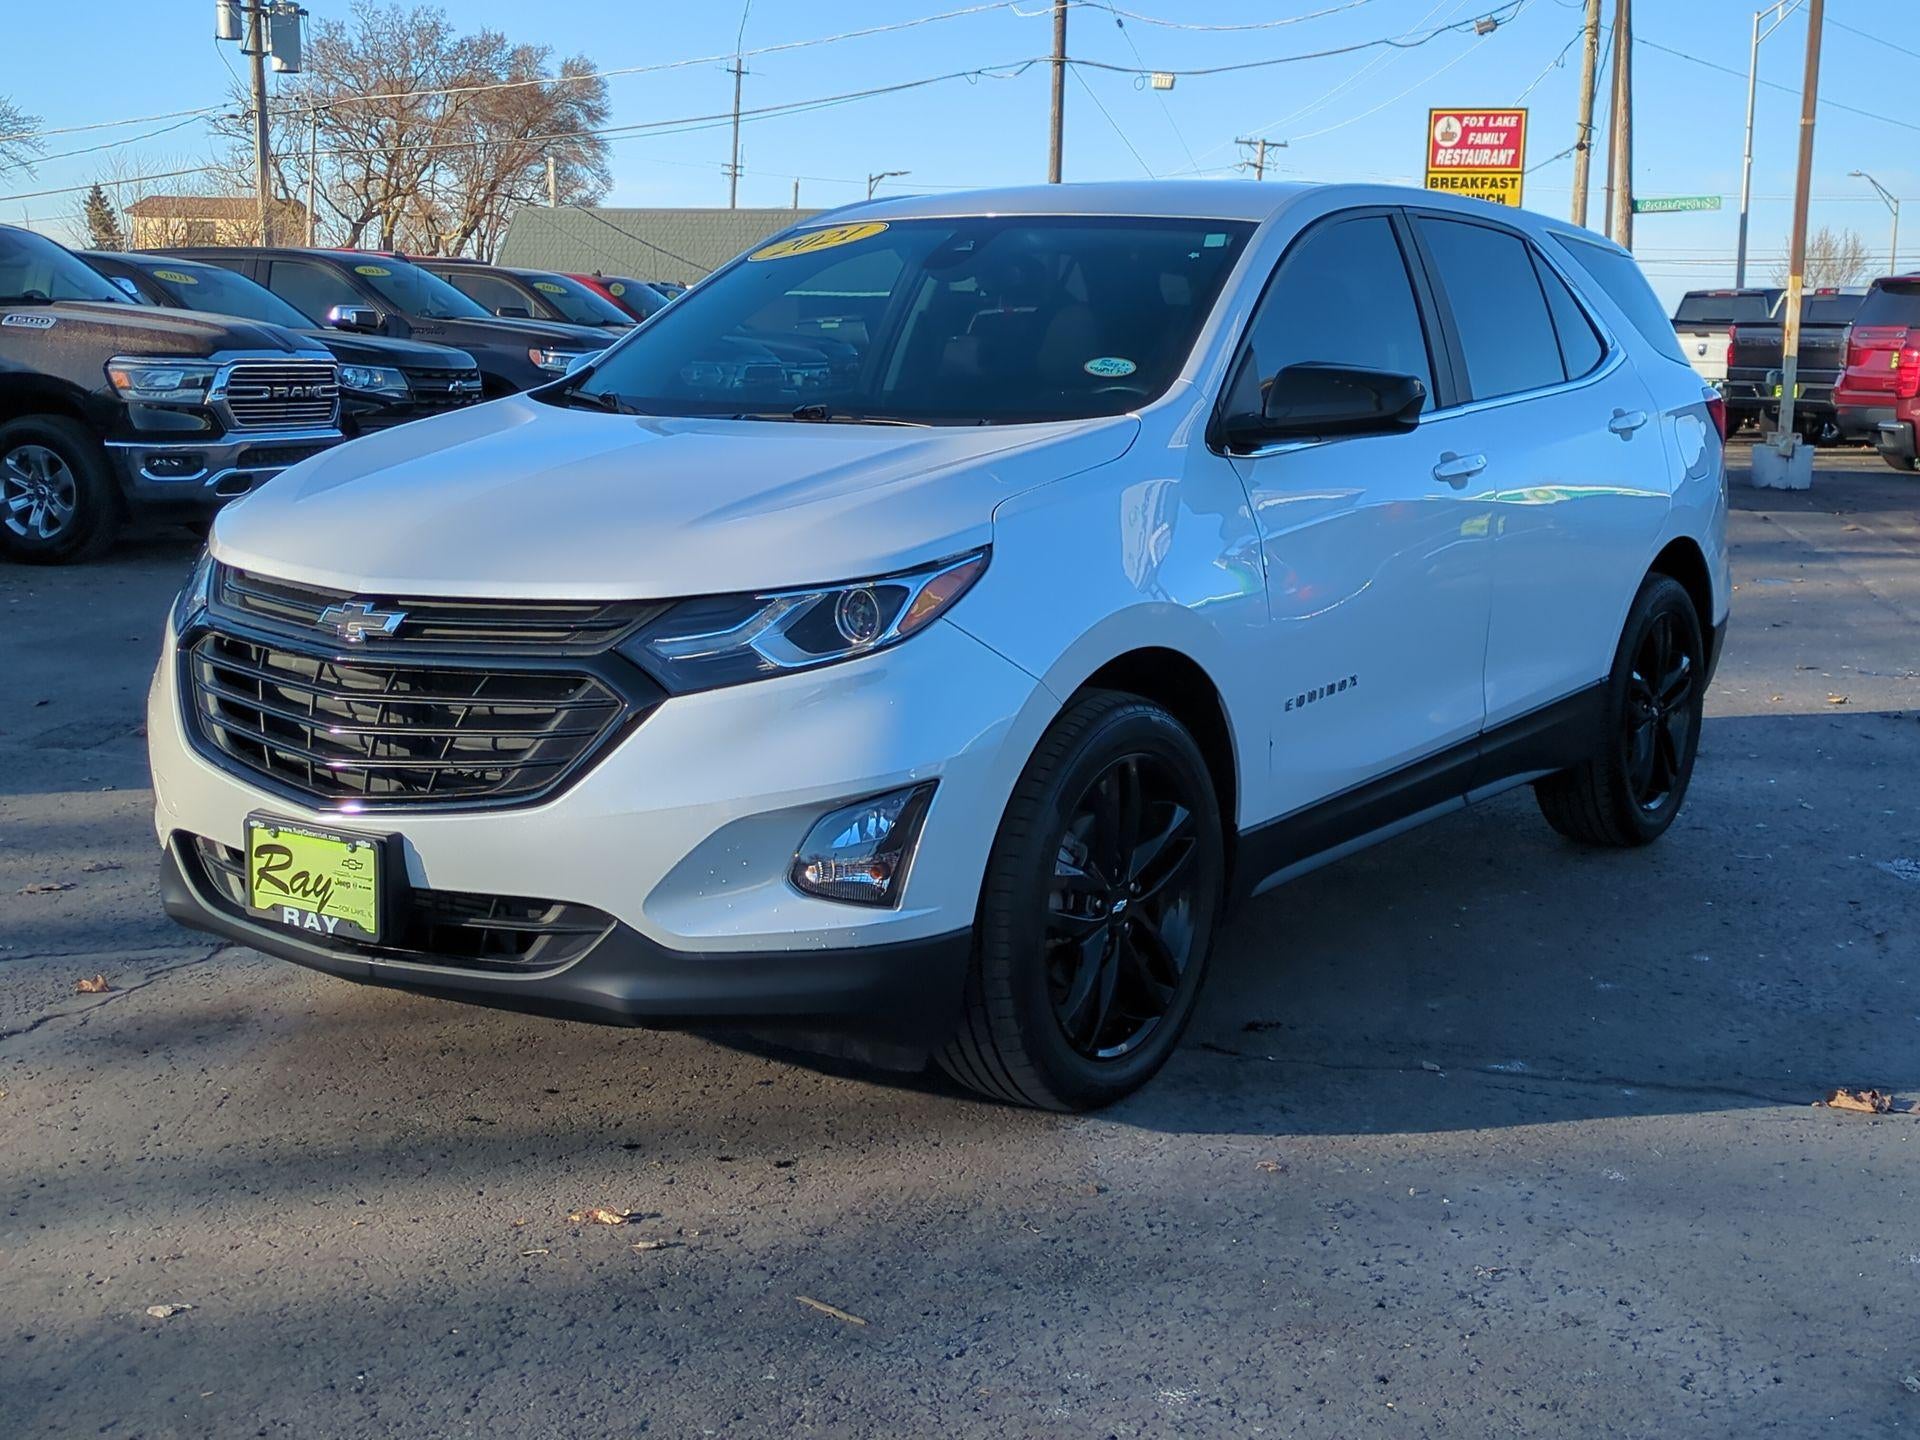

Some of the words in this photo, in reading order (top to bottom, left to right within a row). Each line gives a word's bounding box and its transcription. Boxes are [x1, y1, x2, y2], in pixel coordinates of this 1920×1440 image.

[1462, 116, 1486, 127] FOX
[1488, 116, 1518, 127] LAKE
[1467, 132, 1507, 145] FAMILY
[1435, 148, 1516, 165] RESTAURANT
[1430, 177, 1518, 189] BREAKFAST
[768, 226, 869, 256] 2021
[12, 316, 50, 326] 1500
[1284, 674, 1358, 712] EQUINOX
[254, 844, 335, 913] Ray
[282, 906, 340, 934] RAY
